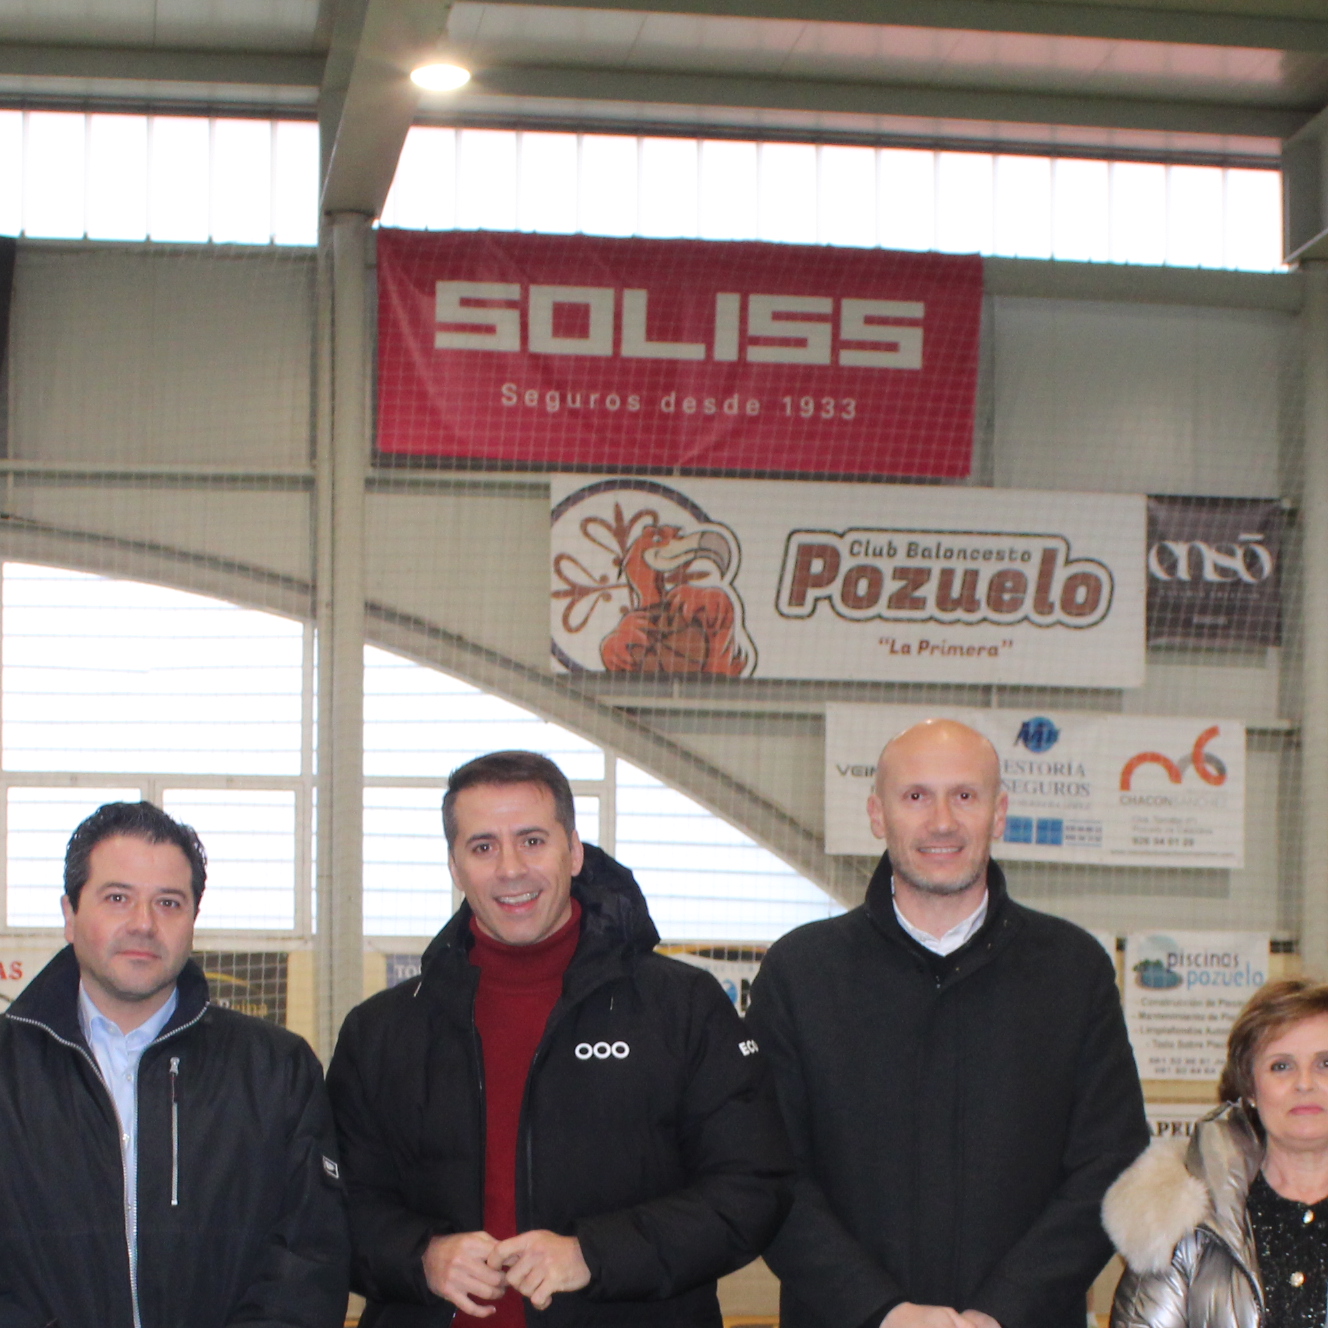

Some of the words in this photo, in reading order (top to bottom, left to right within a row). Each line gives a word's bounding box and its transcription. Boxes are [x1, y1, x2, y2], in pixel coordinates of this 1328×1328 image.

[434, 280, 925, 369] SOLISS
[501, 383, 641, 413] Seguros
[661, 391, 761, 417] desde
[781, 396, 858, 421] 1933
[849, 538, 899, 559] Club
[905, 541, 1033, 565] Baloncesto
[787, 543, 1105, 618] Pozuelo
[1003, 760, 1086, 778] ESTORÍA
[1166, 948, 1241, 973] piscinas
[1186, 960, 1265, 991] pozuelo
